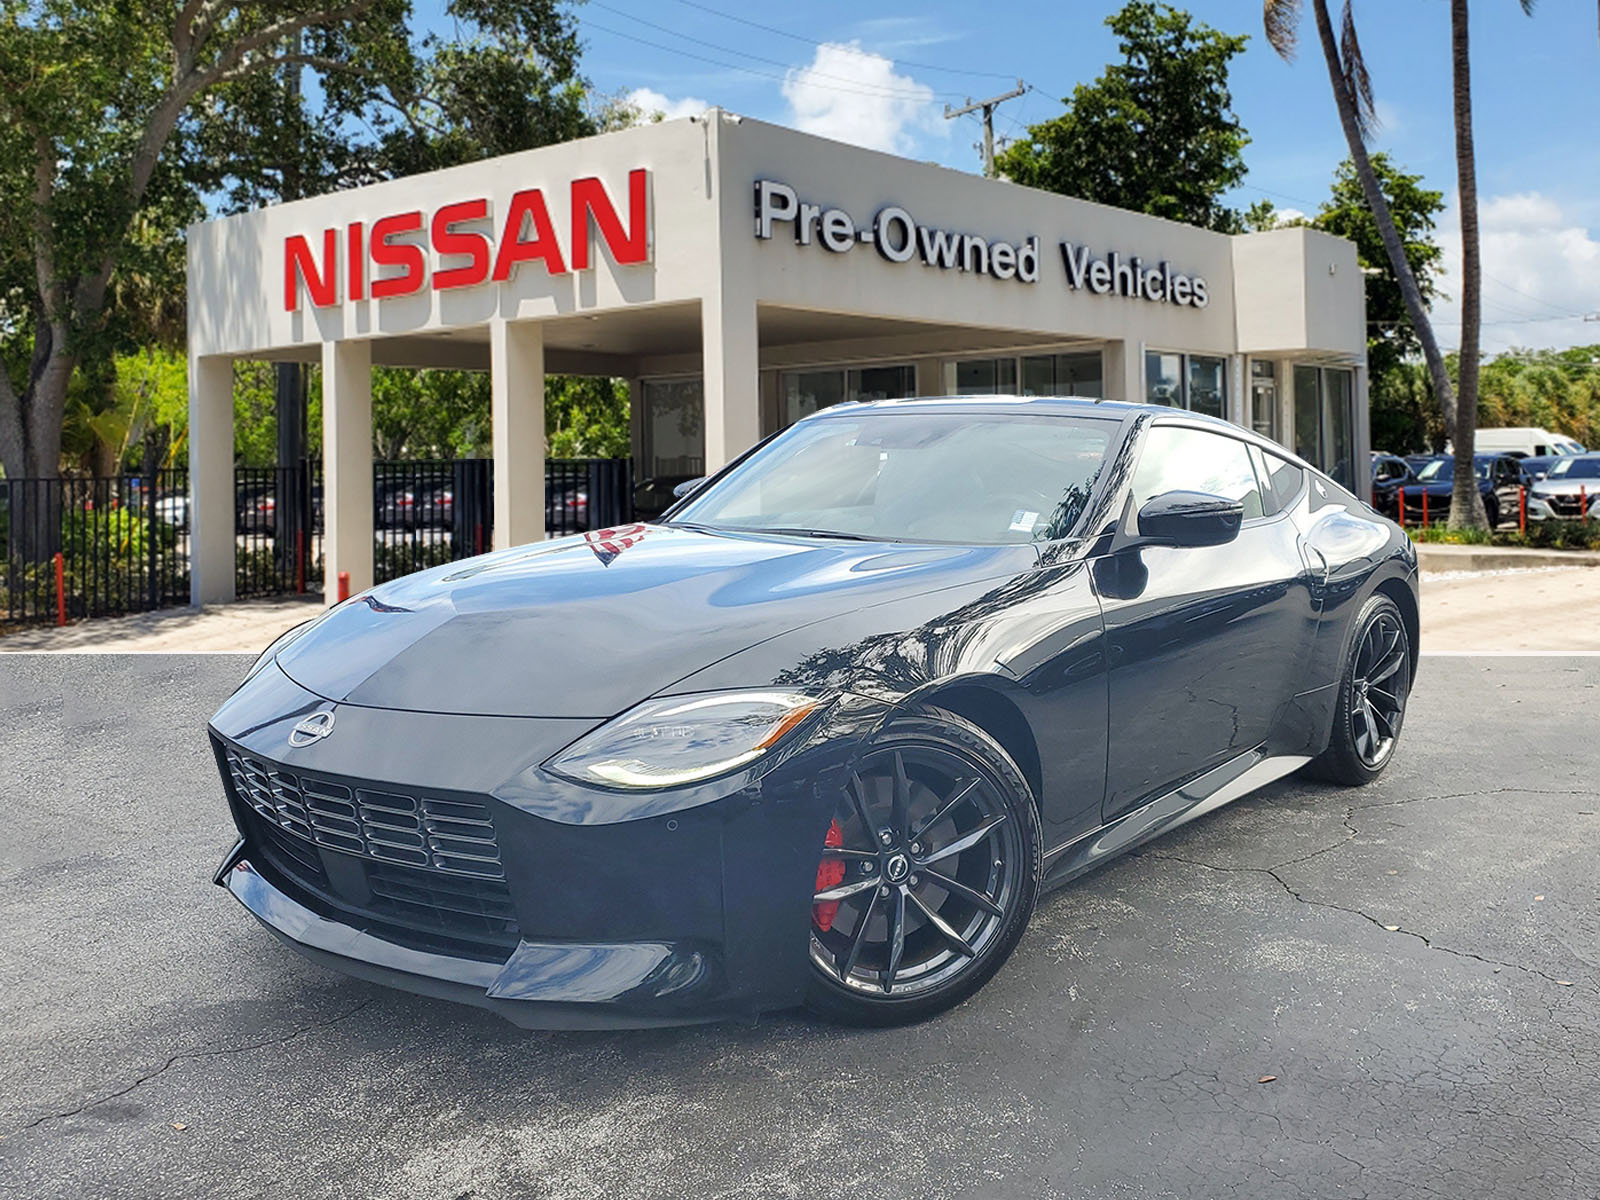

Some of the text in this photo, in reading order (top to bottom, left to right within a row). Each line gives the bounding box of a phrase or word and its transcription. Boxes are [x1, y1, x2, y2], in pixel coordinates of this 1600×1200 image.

[285, 168, 650, 312] NISSAN
[755, 179, 1210, 309] Pre-Owned Vehicles
